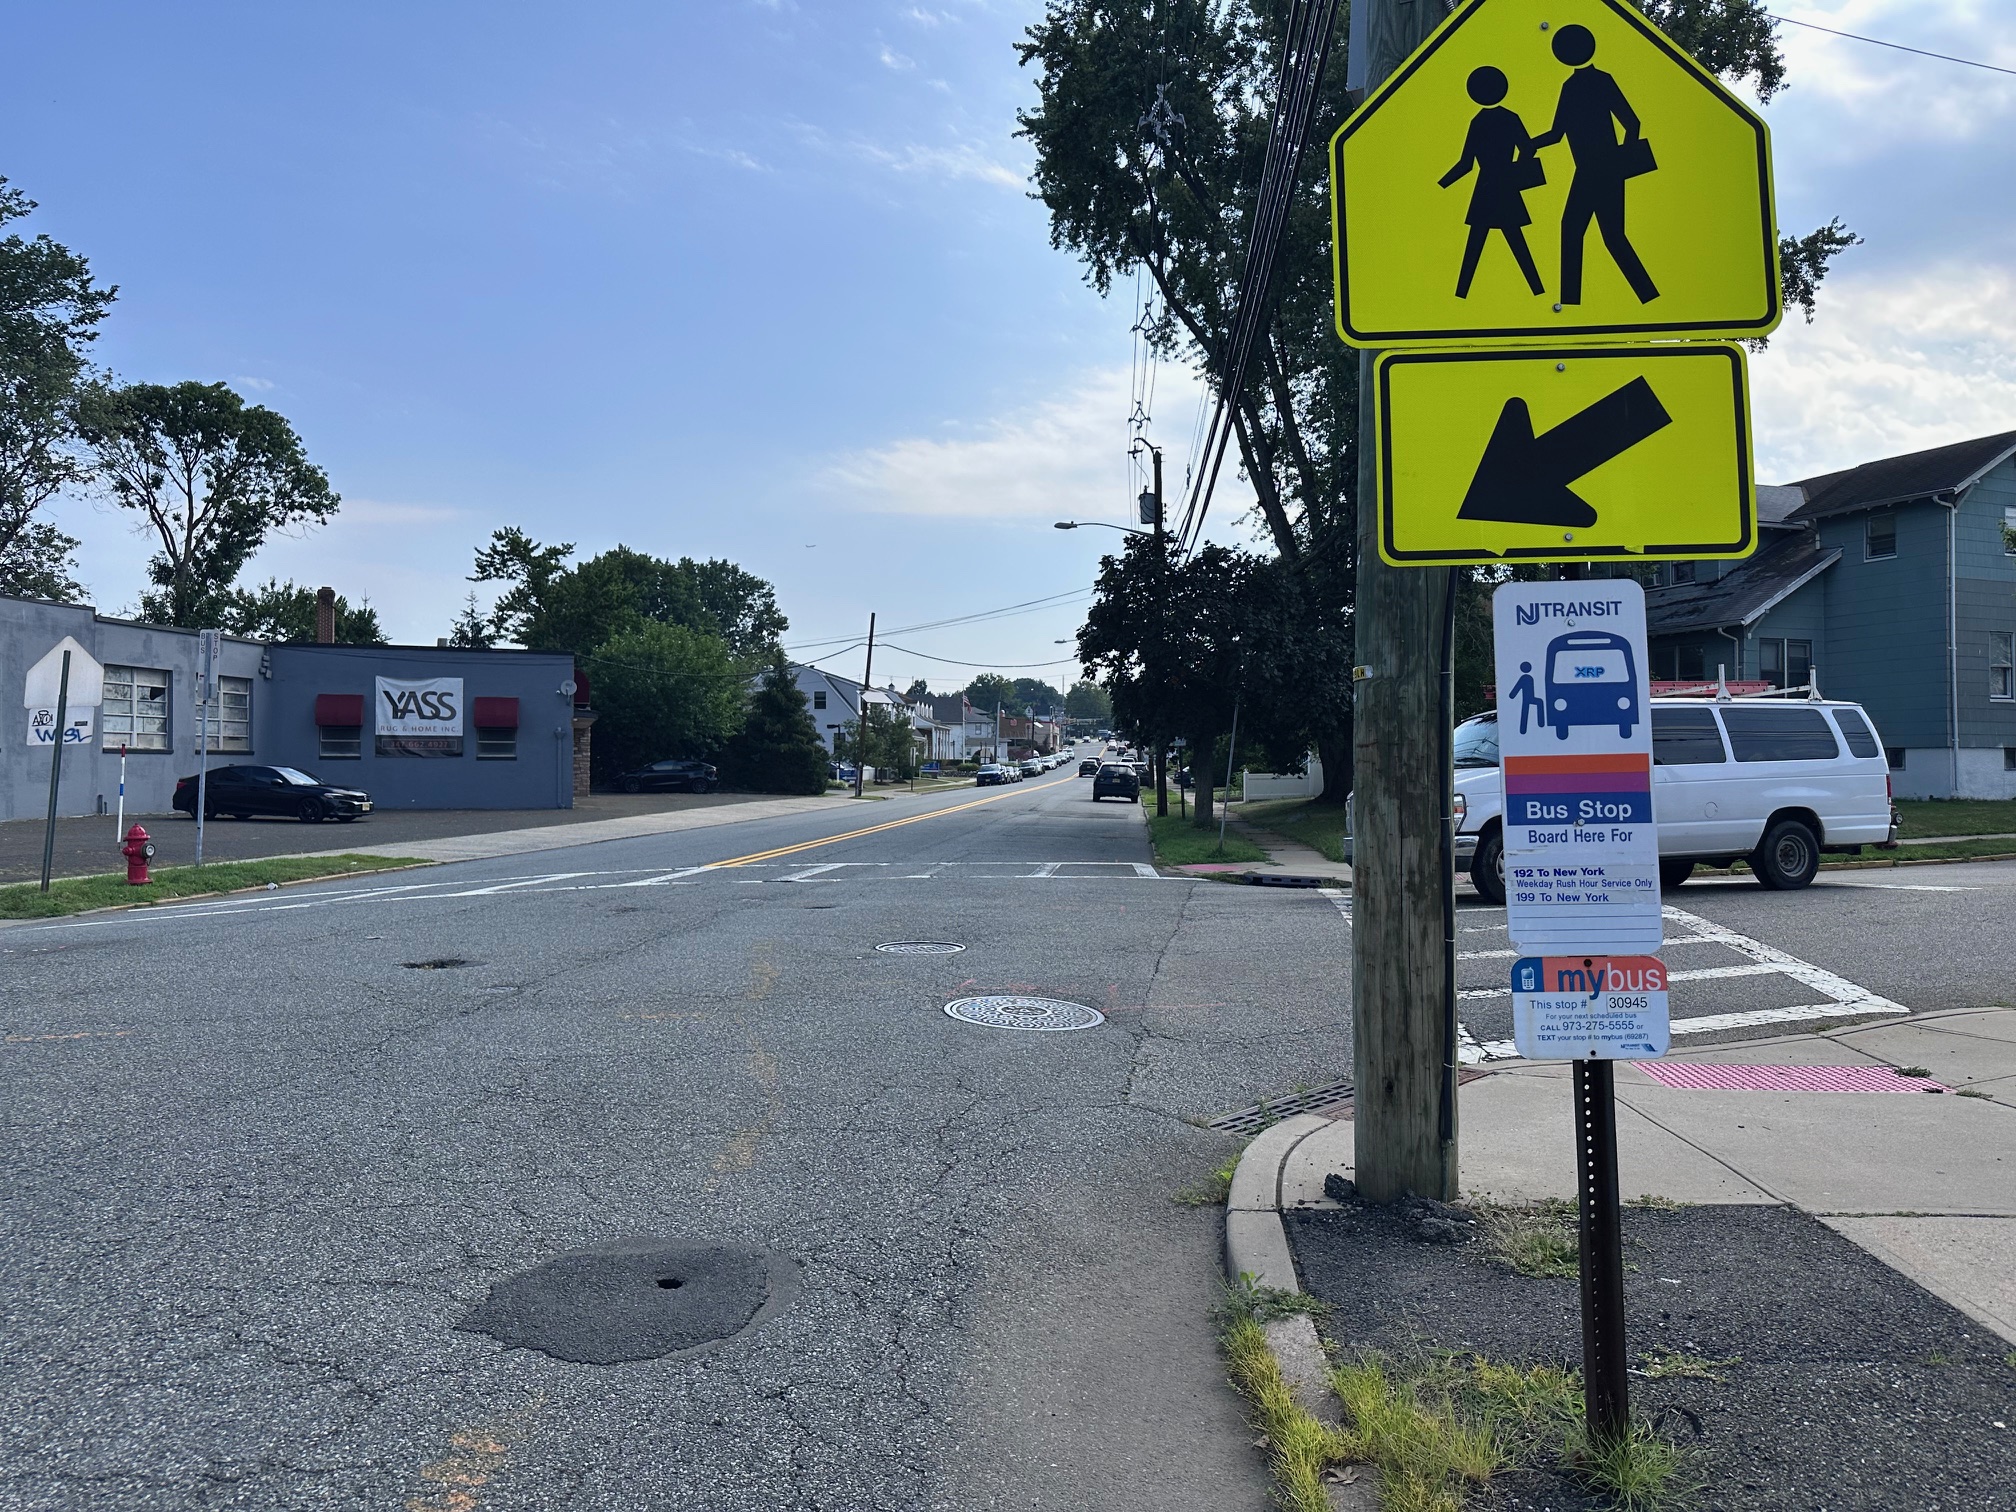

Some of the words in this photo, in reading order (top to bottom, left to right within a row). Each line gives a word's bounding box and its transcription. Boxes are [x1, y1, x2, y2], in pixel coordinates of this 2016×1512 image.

[1574, 666, 1605, 678] XRP
[382, 690, 457, 721] YASS
[1526, 801, 1568, 819] Bus
[1579, 800, 1632, 820] Stop
[1528, 829, 1568, 843] Board
[1574, 829, 1605, 843] Here
[1611, 828, 1633, 842] For
[1513, 869, 1533, 878] 192
[1537, 868, 1550, 877] To
[1553, 868, 1577, 877] New
[1580, 867, 1605, 876] York
[1516, 879, 1553, 889] Weekday
[1556, 880, 1576, 888] Rush
[1579, 879, 1598, 888] Hour
[1601, 879, 1631, 888] Service
[1635, 878, 1652, 888] Only
[1515, 892, 1535, 902] 199
[1539, 893, 1552, 902] To
[1557, 893, 1580, 902] New
[1585, 892, 1609, 902] York
[1558, 962, 1662, 1000] mybus
[1530, 1000, 1552, 1009] This
[1555, 1000, 1578, 1010] stop
[1581, 1000, 1587, 1008] #
[1609, 996, 1648, 1009] 30945
[1590, 1012, 1623, 1020] scheduled
[1562, 1021, 1634, 1031] 973-275-5555
[1601, 1034, 1623, 1042] mybus
[1624, 1033, 1649, 1041] (69287)
